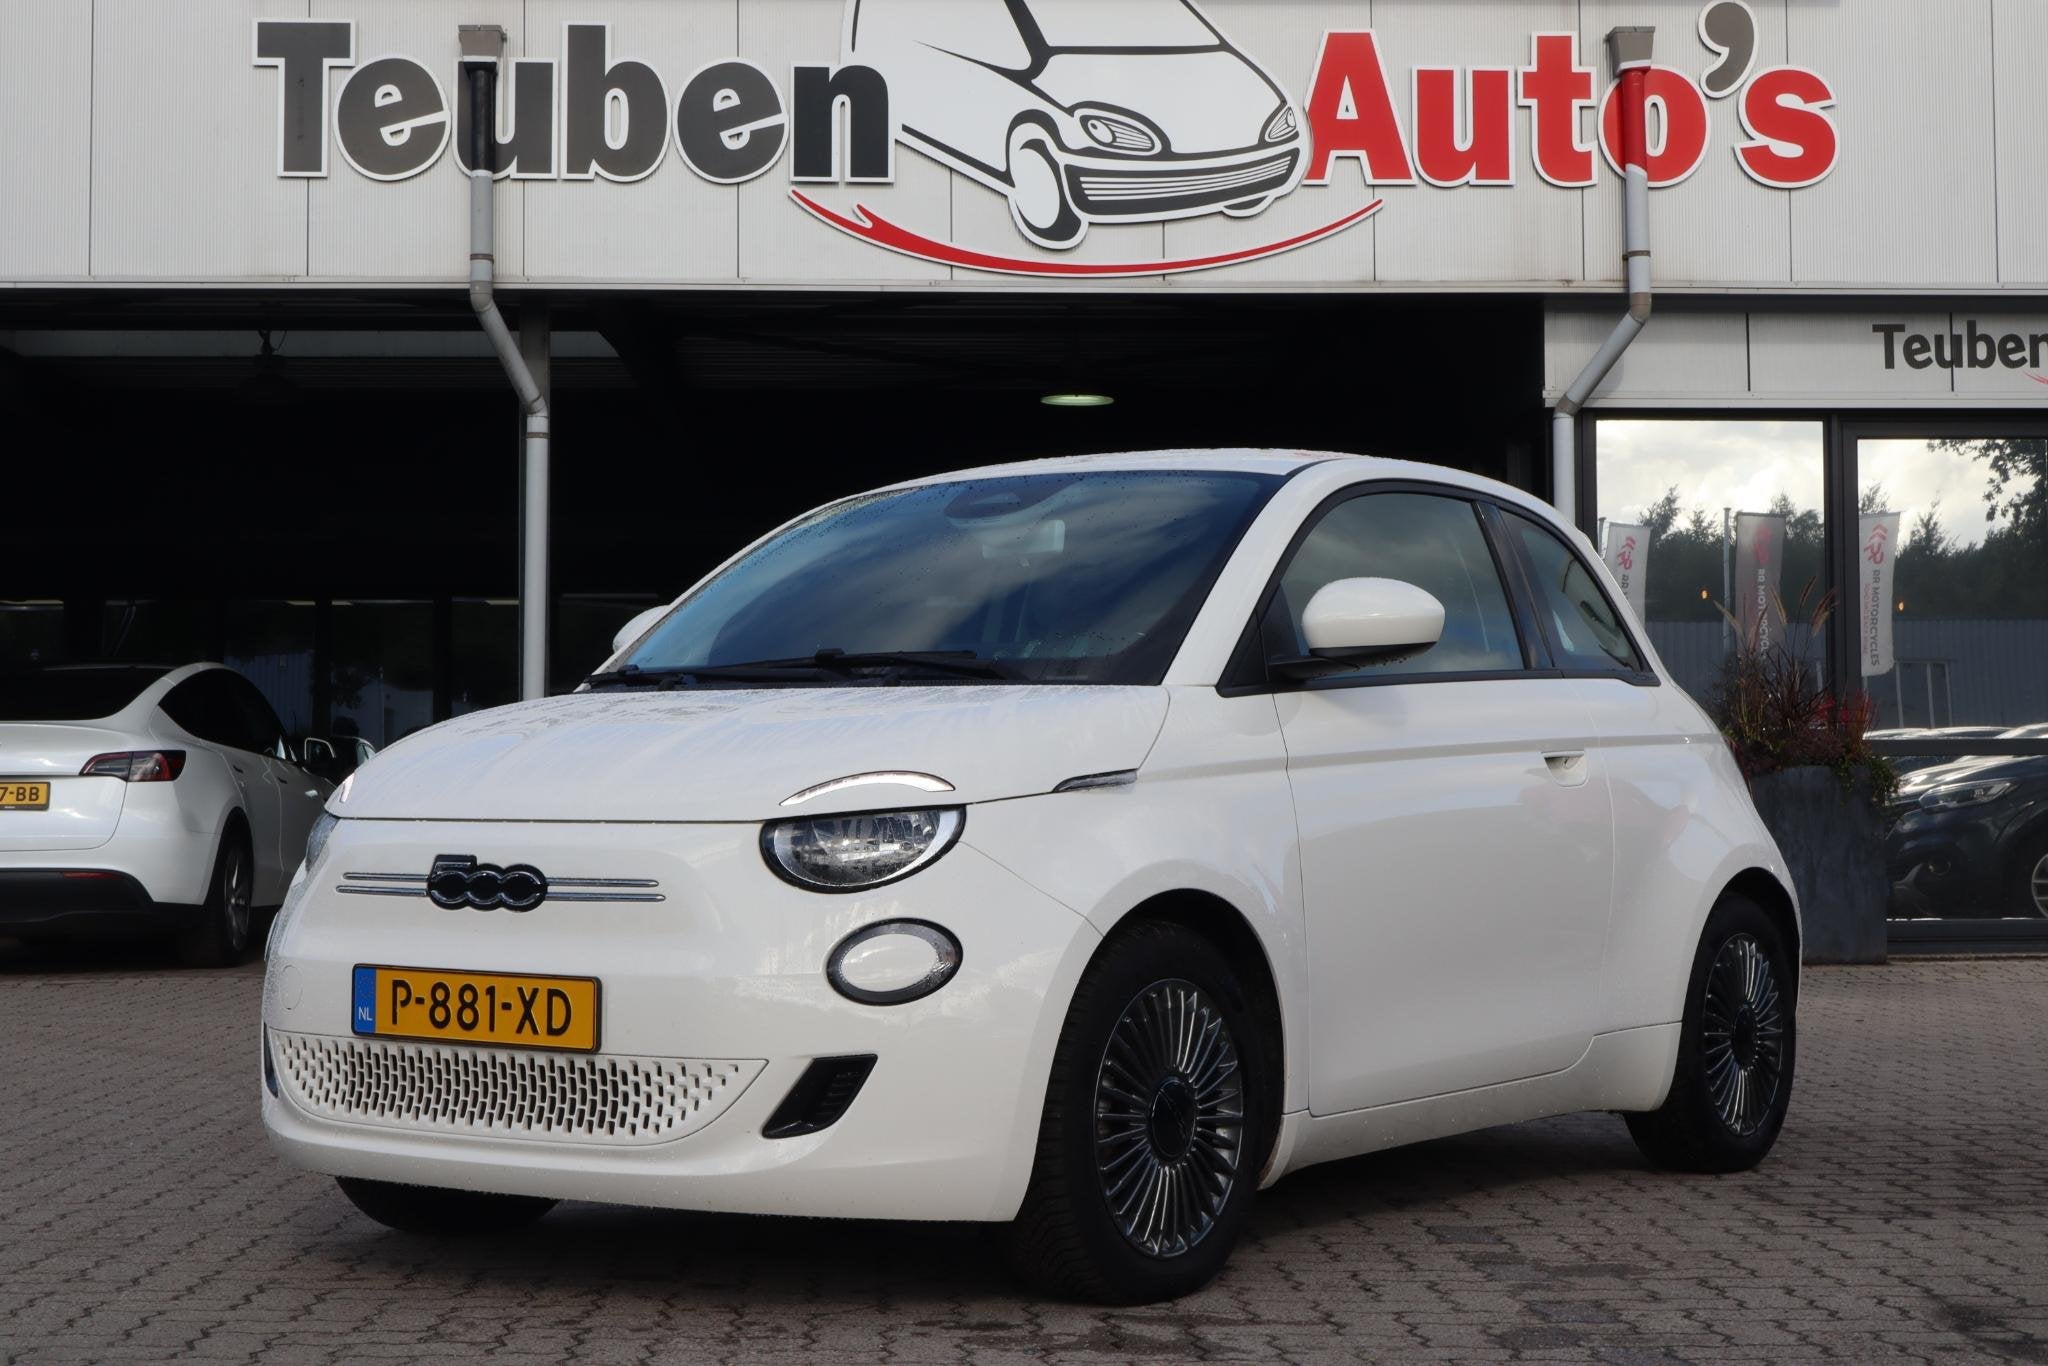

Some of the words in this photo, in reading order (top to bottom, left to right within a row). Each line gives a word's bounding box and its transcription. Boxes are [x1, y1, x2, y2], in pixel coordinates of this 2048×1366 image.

[252, 19, 894, 184] Teuben
[1302, 0, 1838, 188] Auto's
[1870, 587, 1880, 666] MOTORCYCLES
[0, 786, 40, 802] 7-BB
[427, 854, 548, 913] 500
[358, 1005, 373, 1022] NL
[391, 978, 572, 1037] P-881-XD
